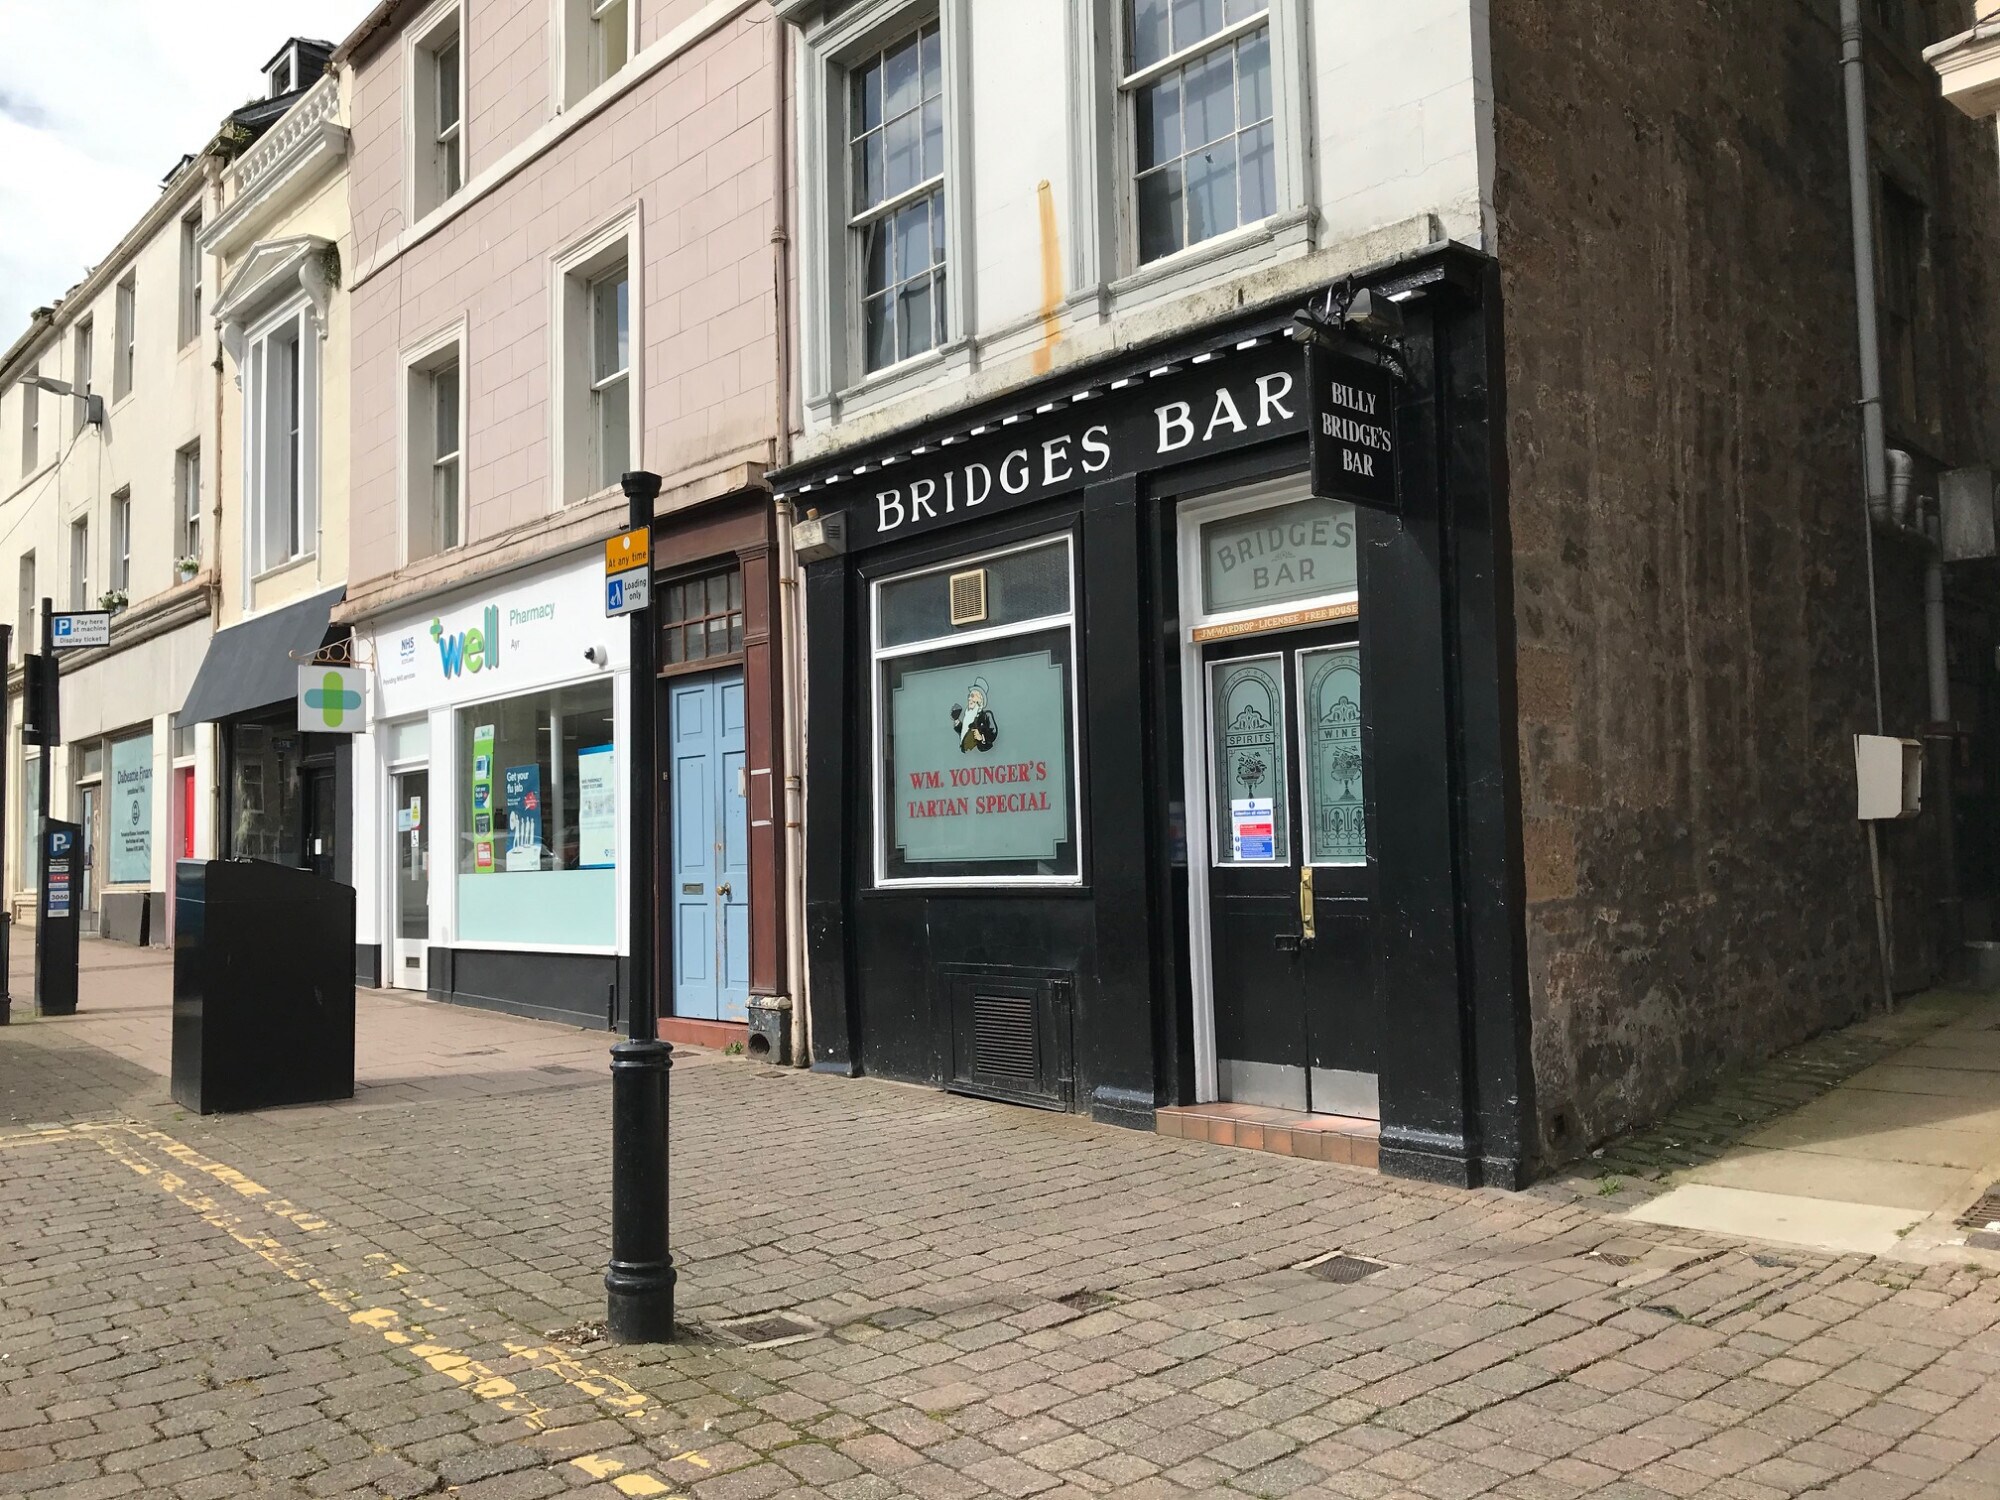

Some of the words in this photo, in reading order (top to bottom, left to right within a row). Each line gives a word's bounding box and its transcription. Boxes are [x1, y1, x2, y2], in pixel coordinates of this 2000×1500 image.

[1331, 381, 1376, 415] BILLY
[1321, 412, 1392, 452] BRIDGE'S
[875, 425, 1111, 533] BRIDGES
[1153, 371, 1295, 454] BAR
[1342, 448, 1375, 478] BAR
[608, 559, 616, 568] At
[618, 556, 629, 566] any
[631, 551, 647, 561] time
[1253, 558, 1315, 590] BAR
[624, 578, 647, 591] Loading
[629, 590, 641, 601] only
[1259, 613, 1300, 628] LICENSEE
[1328, 604, 1358, 616] HOUSE
[60, 619, 69, 635] P
[59, 637, 82, 645] Display
[401, 636, 415, 651] NHS
[439, 604, 499, 680] well
[509, 602, 555, 627] Pharmacy
[510, 639, 520, 651] Ayr
[1229, 733, 1272, 745] SPIRITS
[506, 772, 516, 782] Get
[517, 772, 529, 783] your
[909, 771, 945, 790] WM.
[949, 761, 1047, 787] YOUNGER'S
[514, 782, 523, 795] jab
[907, 797, 969, 818] TARTAN
[975, 792, 1052, 815] SPECIAL
[53, 833, 67, 852] P
